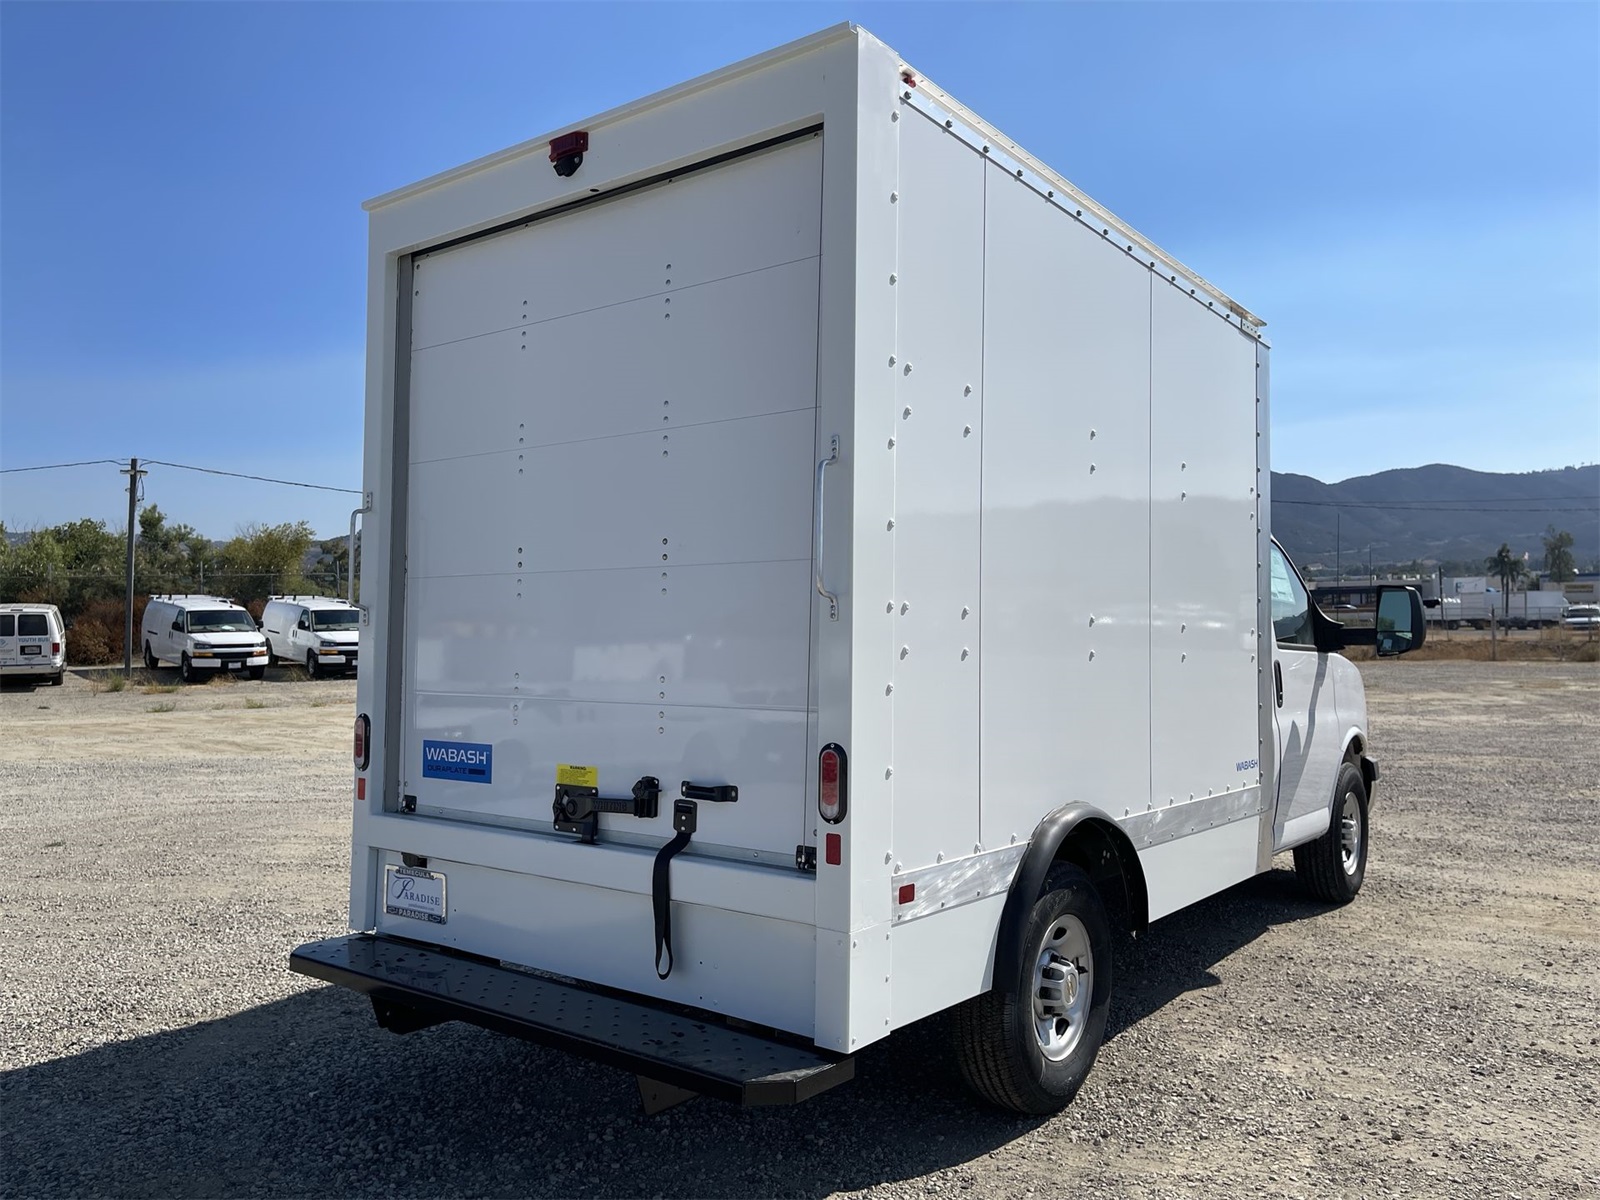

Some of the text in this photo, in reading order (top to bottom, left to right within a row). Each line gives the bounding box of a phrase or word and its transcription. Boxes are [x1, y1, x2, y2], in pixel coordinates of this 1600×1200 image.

[426, 747, 487, 765] WABASH
[427, 765, 468, 775] DURAPLATE
[1236, 760, 1258, 771] WABASH
[400, 868, 430, 878] TEMECULA
[391, 873, 441, 906] PARADISE
[398, 907, 429, 921] PARADISE
